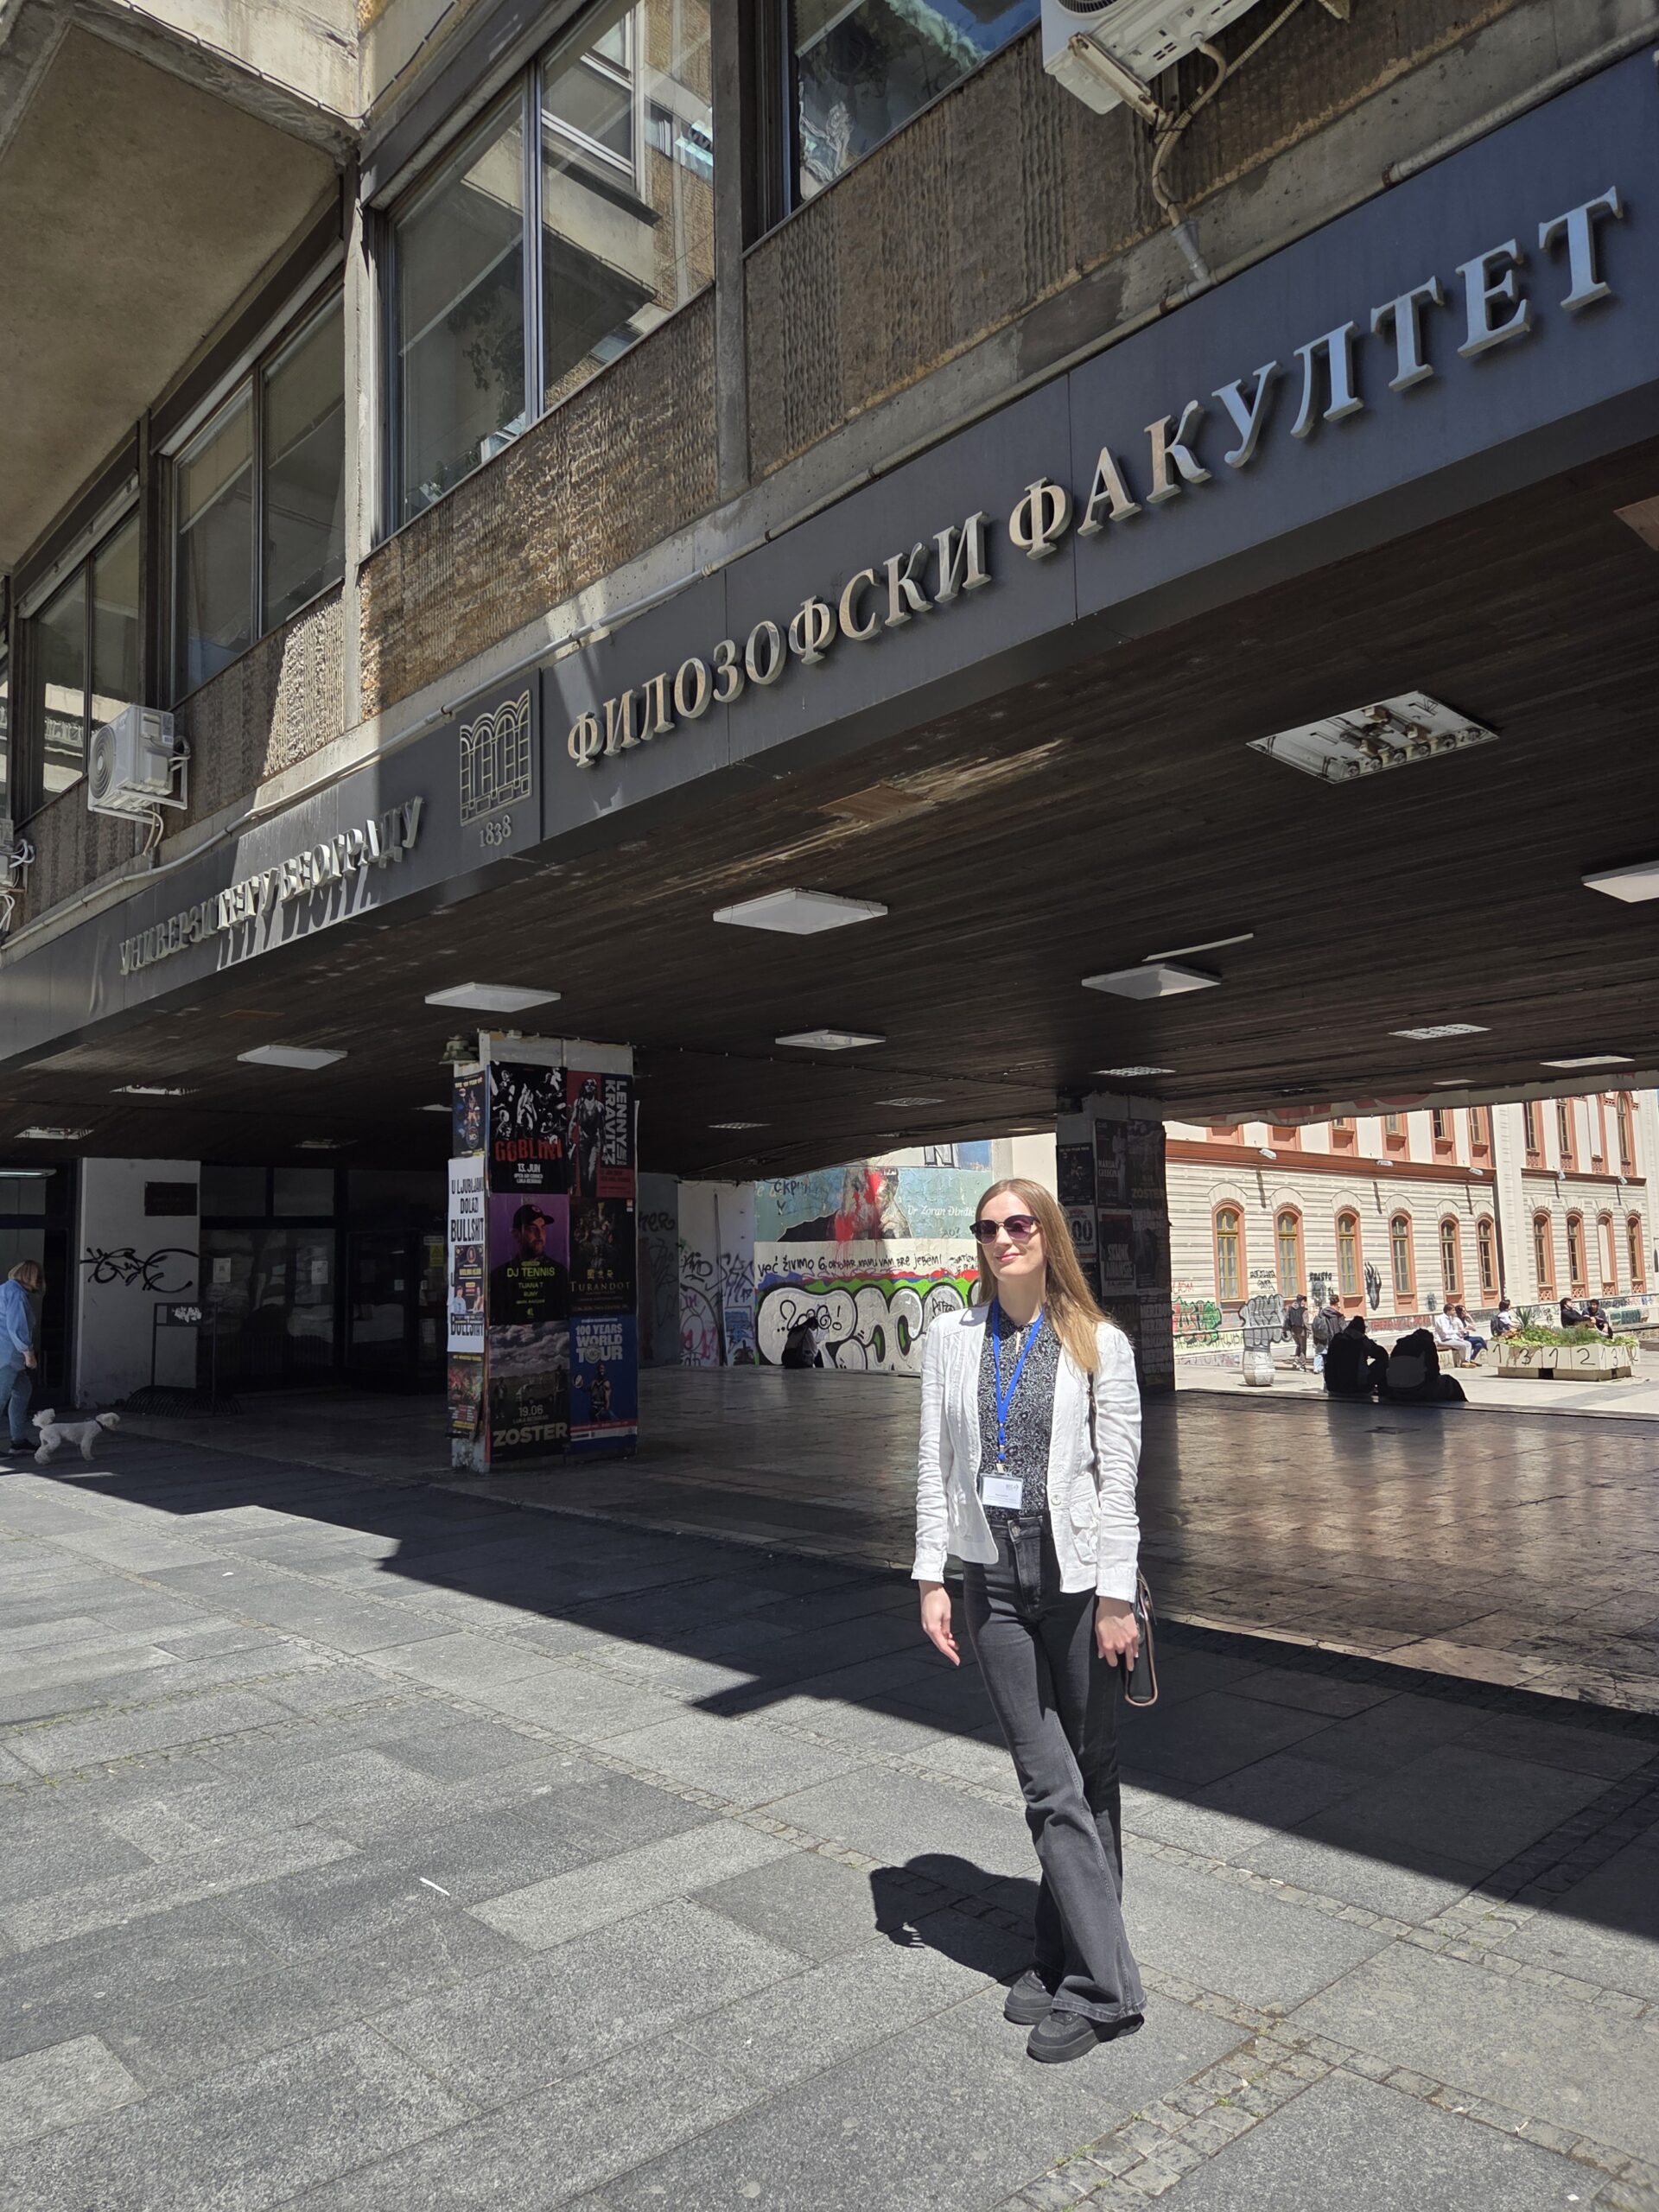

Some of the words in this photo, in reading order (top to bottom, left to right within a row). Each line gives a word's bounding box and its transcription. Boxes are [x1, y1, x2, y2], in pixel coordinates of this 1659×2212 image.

[568, 511, 993, 768] ФИЛОЗОФСКИ
[1008, 186, 1624, 560] ФАКУЛТЕТ
[479, 814, 512, 848] 1838
[604, 1079, 617, 1166] KRAVITZ
[616, 1080, 627, 1147] LENNY
[494, 1138, 563, 1162] GOBLINI
[450, 1217, 484, 1243] BULLSHIT
[506, 1267, 519, 1278] DJ
[520, 1267, 556, 1277] TENNIS
[569, 1281, 631, 1293] TURANDOT
[575, 1325, 591, 1336] 100
[592, 1323, 623, 1335] YEARS
[575, 1334, 623, 1347] WORLD
[493, 1422, 568, 1447] ZOSTER
